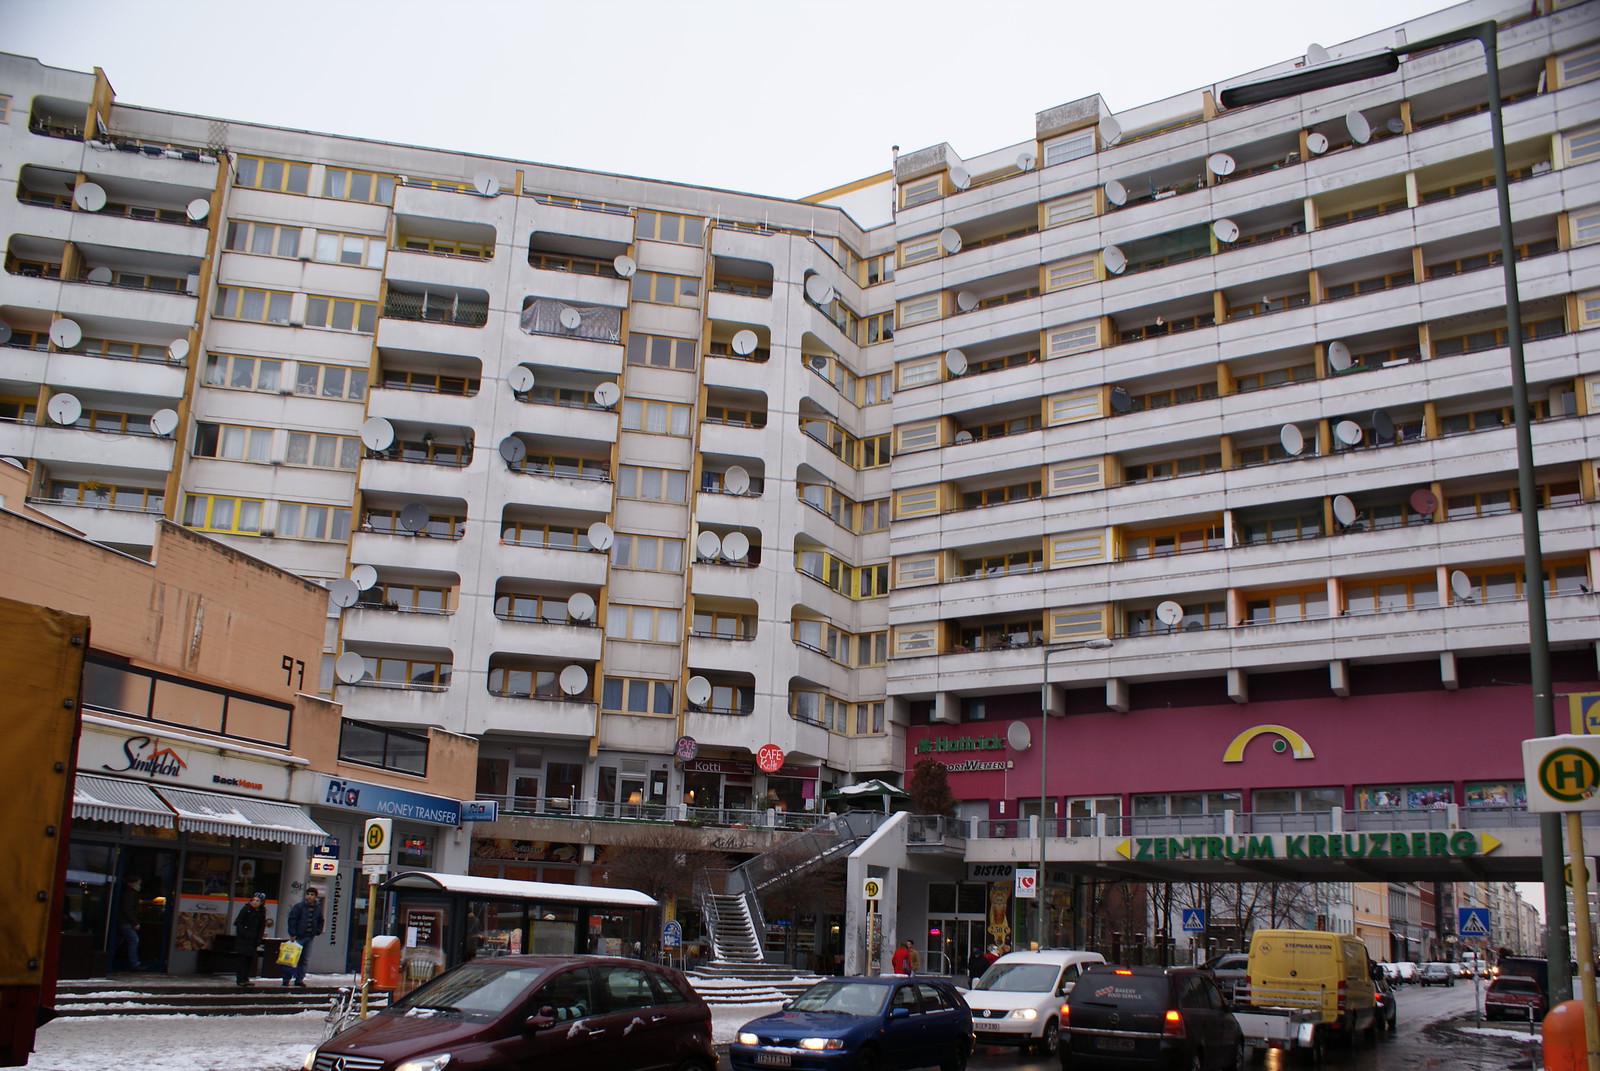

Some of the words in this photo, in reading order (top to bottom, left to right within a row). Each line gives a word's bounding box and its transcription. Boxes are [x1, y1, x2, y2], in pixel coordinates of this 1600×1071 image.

[678, 738, 696, 750] CAFE
[935, 734, 1004, 752] Hattrick
[676, 747, 694, 759] Kotti
[759, 748, 782, 761] CAFE
[695, 761, 721, 772] Kotti
[1554, 759, 1585, 790] H
[326, 780, 360, 807] Ria
[377, 800, 415, 817] MONEY
[415, 805, 457, 824] TRANSFER
[468, 803, 486, 814] Ria
[369, 830, 378, 844] H
[1134, 835, 1275, 860] ZENTRUM
[1286, 830, 1477, 857] KREUZBERG
[973, 864, 1012, 876] BISTRO
[330, 873, 343, 946] Geldautomat
